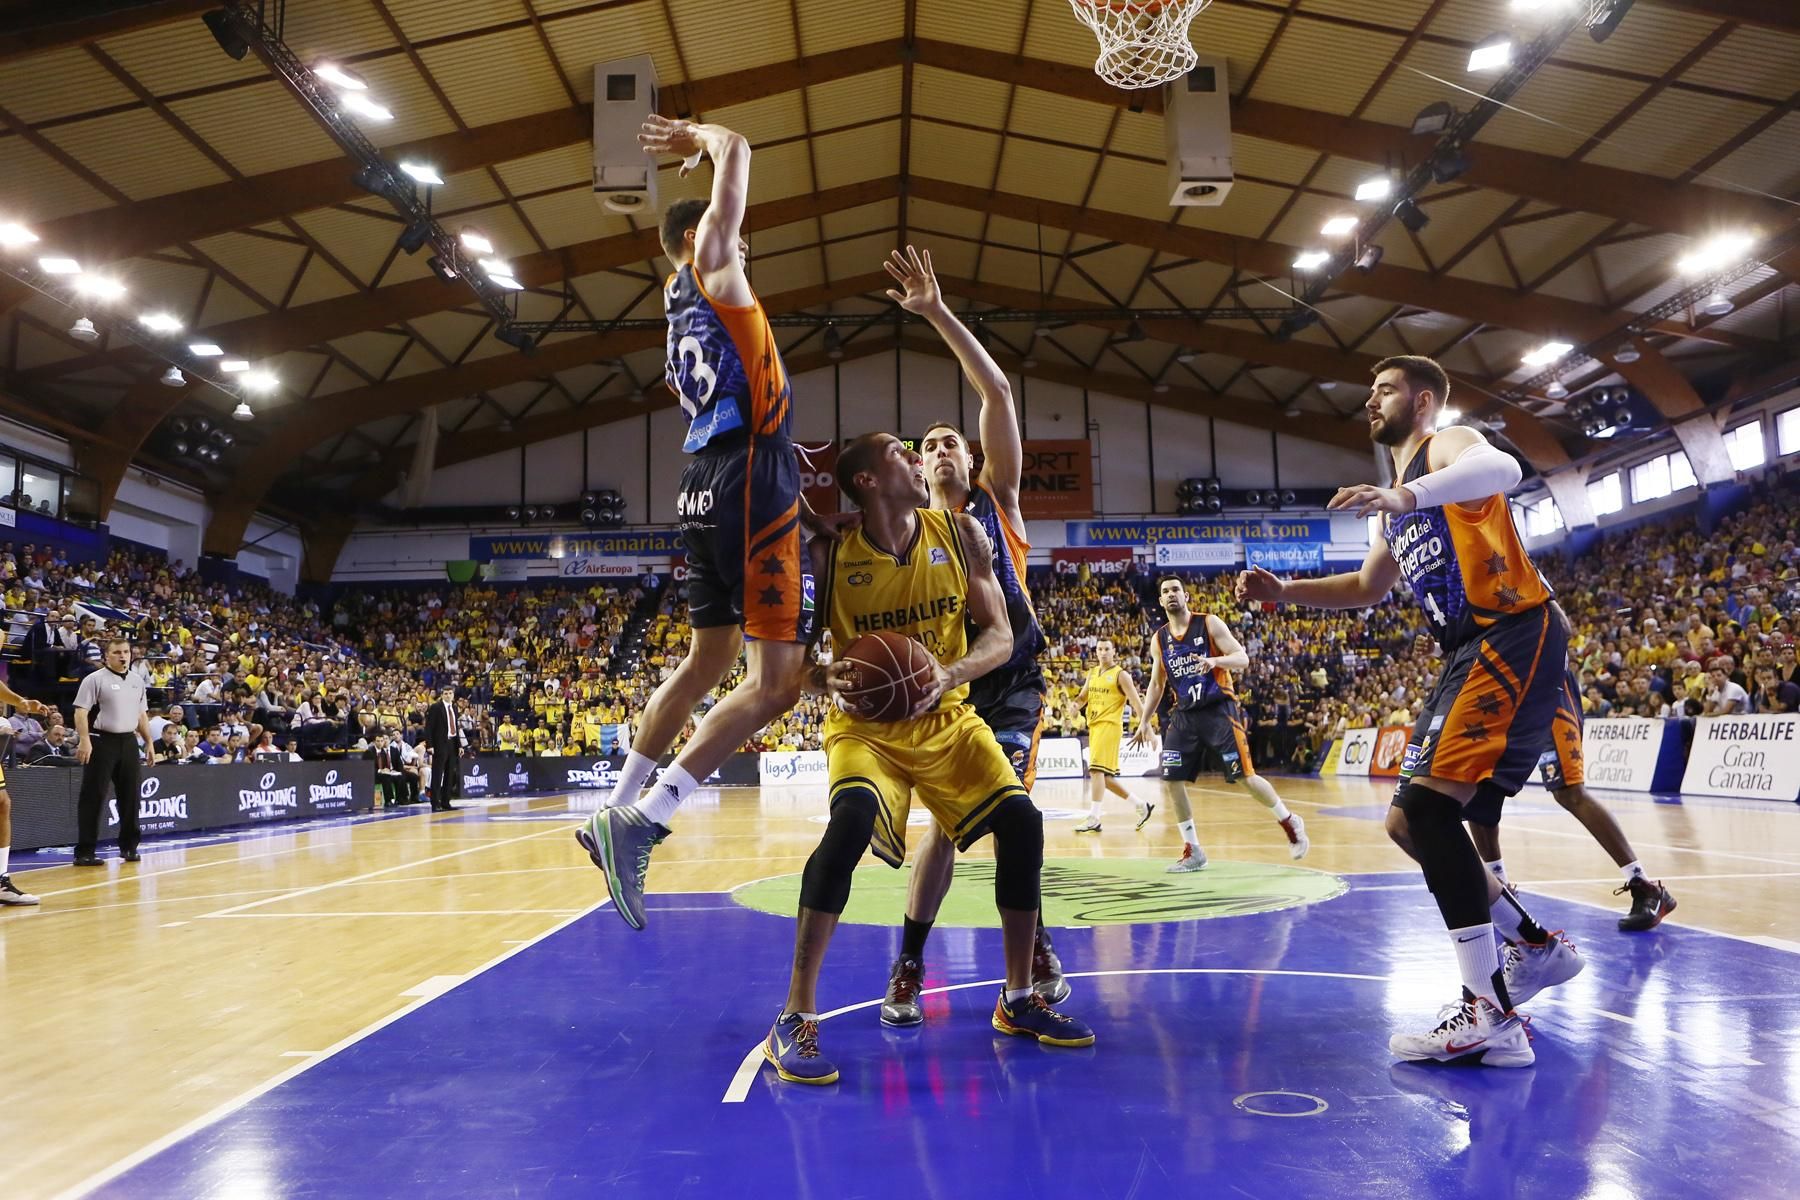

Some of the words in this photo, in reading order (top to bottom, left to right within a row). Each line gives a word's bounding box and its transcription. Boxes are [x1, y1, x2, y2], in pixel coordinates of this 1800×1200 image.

[1088, 521, 1310, 545] www.grancanaria.com
[585, 564, 633, 576] AirEuropa
[843, 559, 873, 569] SPALDING
[1056, 559, 1131, 574] Caarias7
[853, 595, 957, 633] HERBALIFE
[1187, 682, 1203, 702] 17
[1588, 724, 1651, 741] HERBALIFE
[1708, 721, 1796, 741] HERBALIFE
[1037, 757, 1079, 769] VINIA
[1723, 744, 1765, 769] Gran
[567, 769, 622, 783] SPALDI
[765, 757, 790, 778] liga
[797, 759, 827, 772] ende
[1708, 765, 1773, 791] Canaria
[239, 786, 297, 812] SPALDING
[309, 782, 352, 804] SPALDING
[108, 794, 188, 826] SLDING
